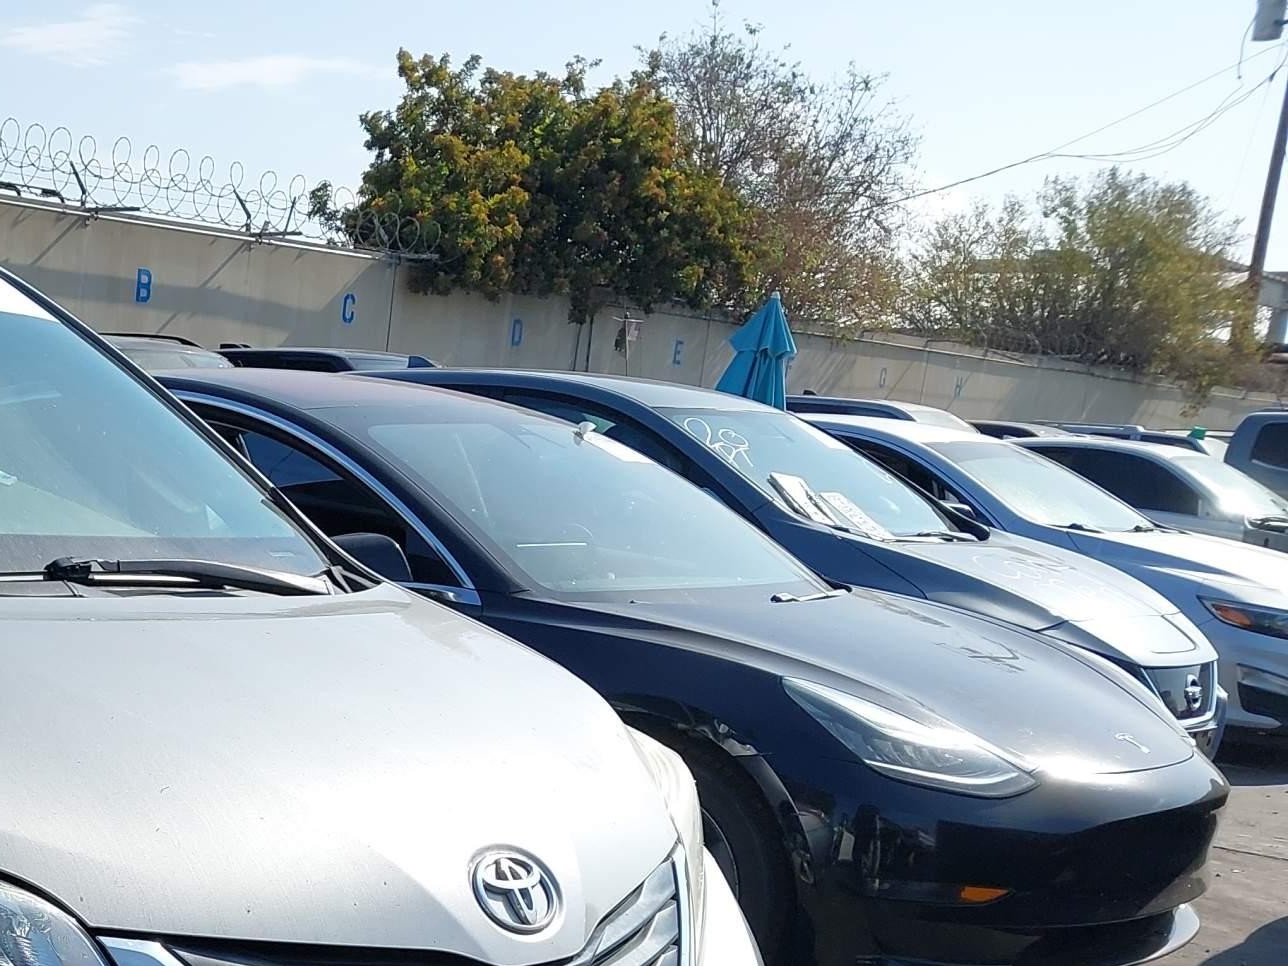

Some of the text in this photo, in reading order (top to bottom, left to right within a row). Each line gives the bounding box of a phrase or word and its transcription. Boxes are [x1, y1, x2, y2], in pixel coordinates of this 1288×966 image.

[135, 268, 153, 303] B
[342, 293, 357, 324] C
[511, 318, 523, 346] D
[673, 339, 684, 365] E
